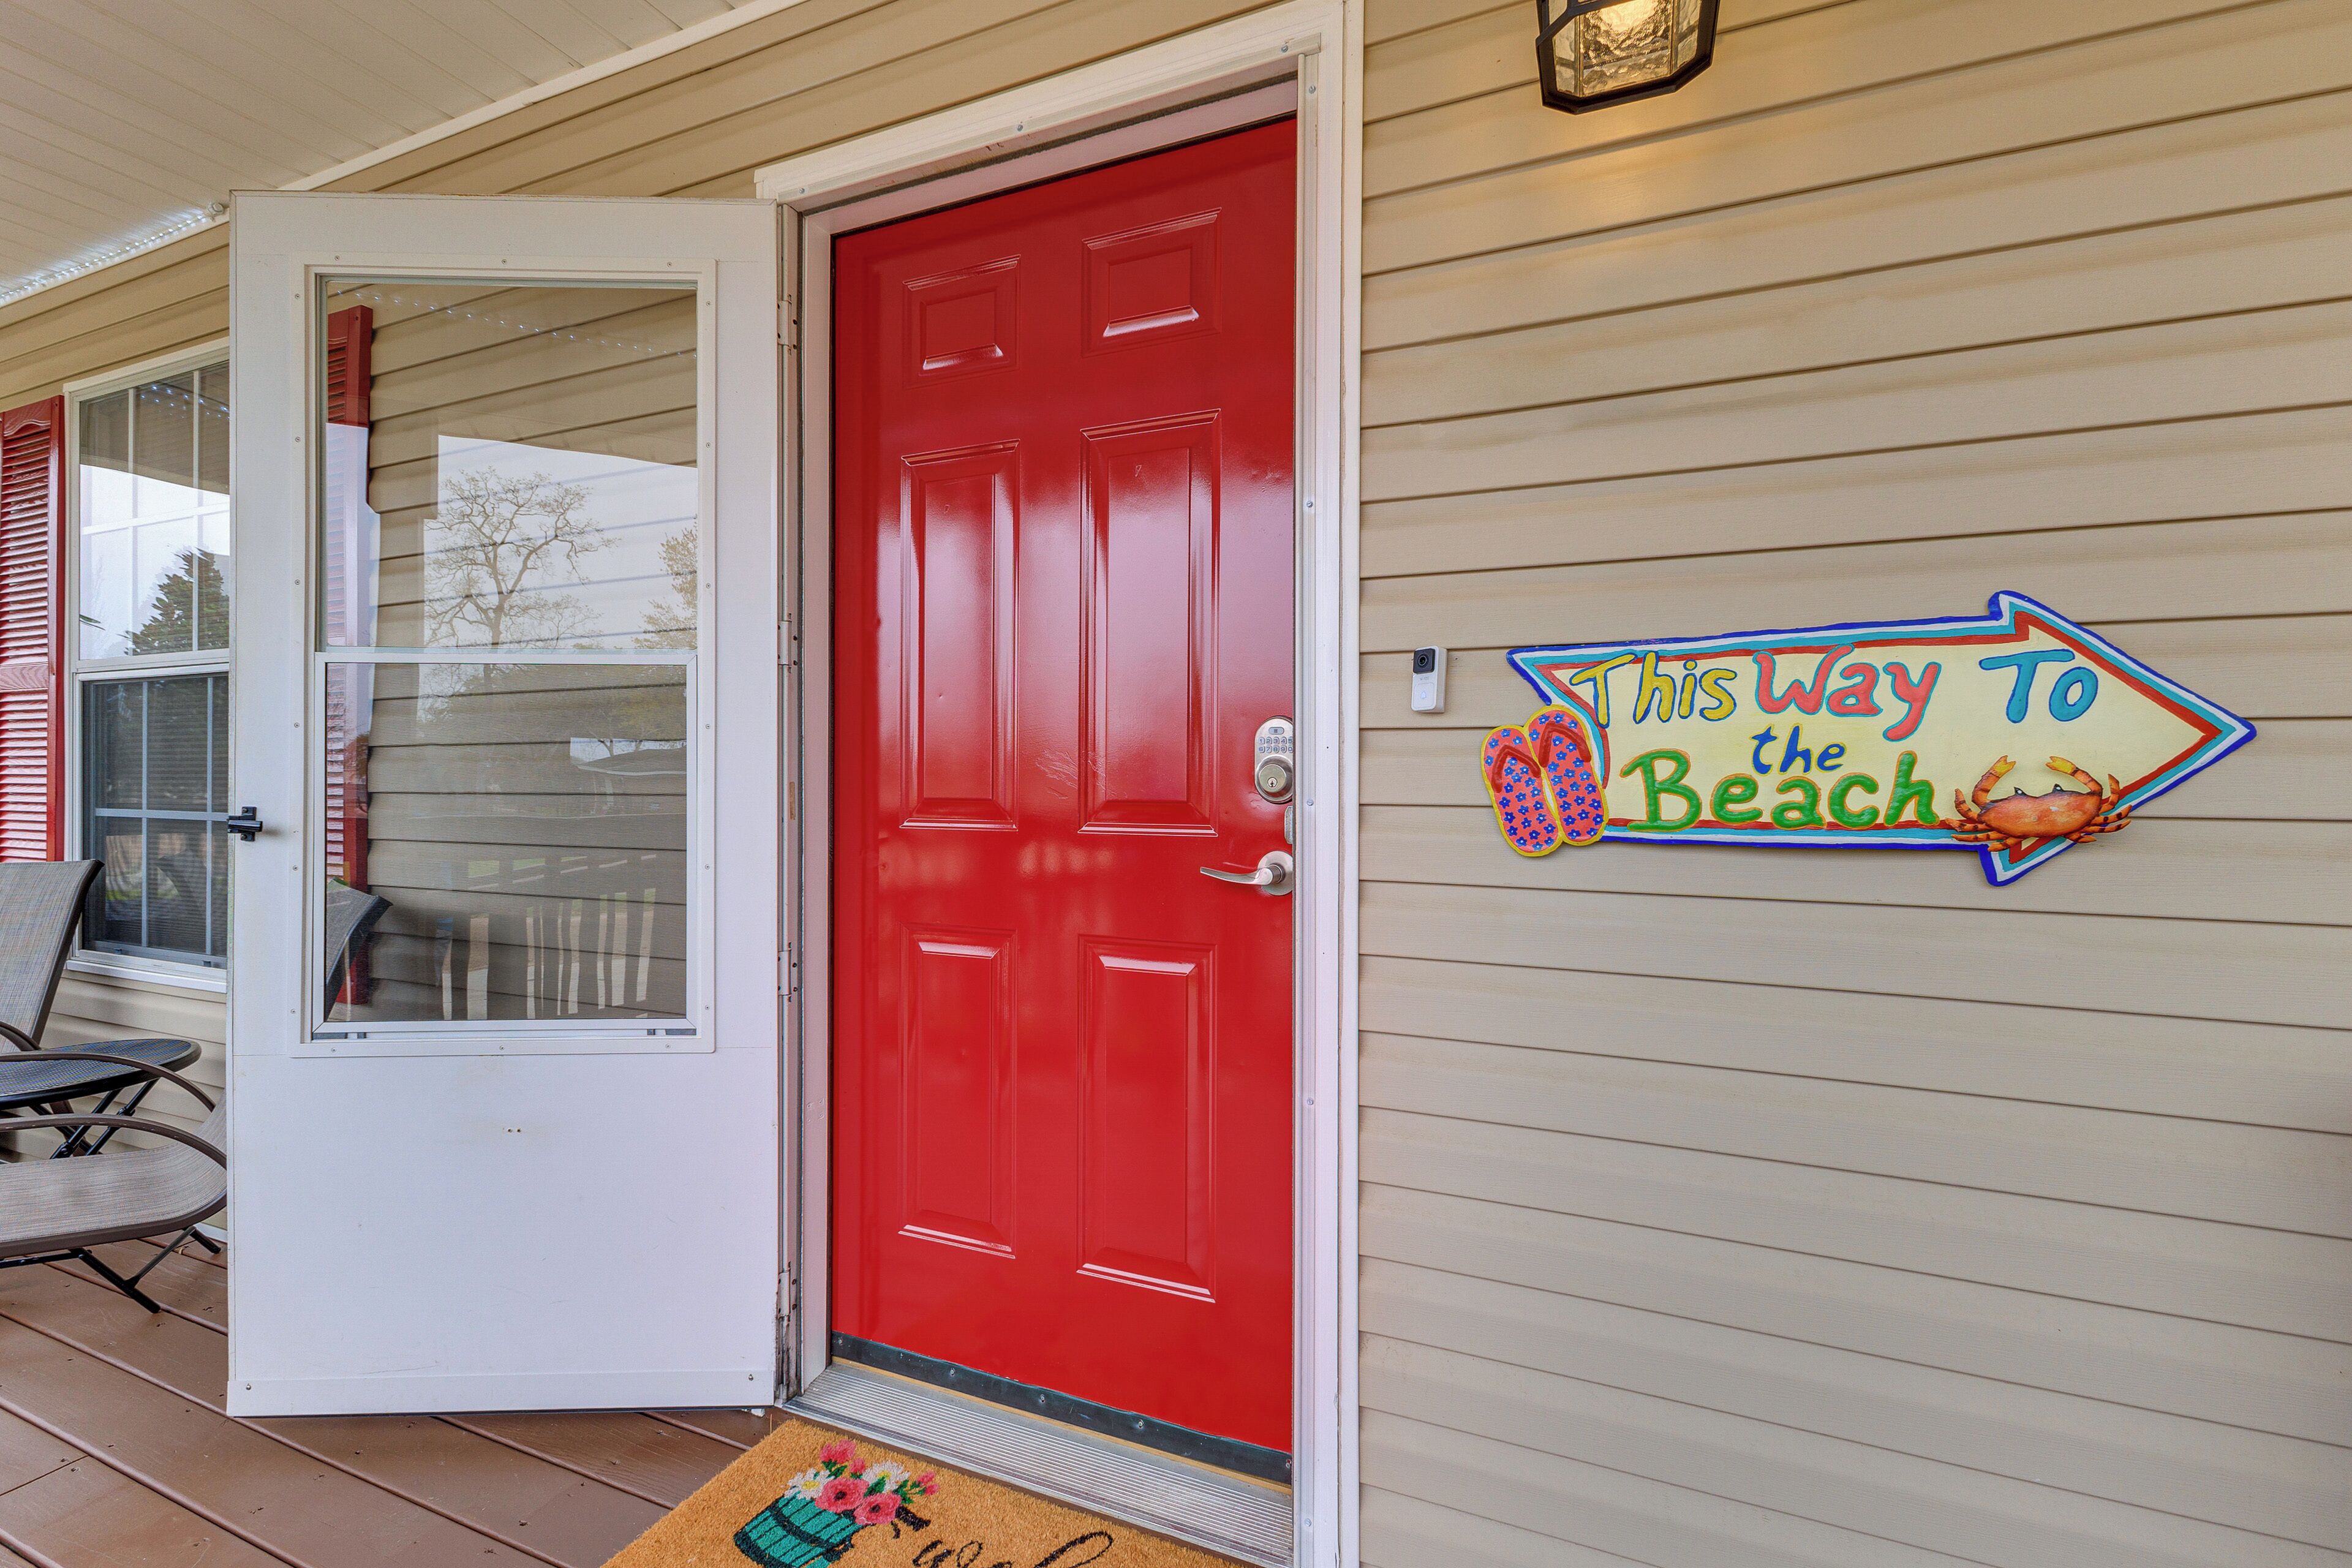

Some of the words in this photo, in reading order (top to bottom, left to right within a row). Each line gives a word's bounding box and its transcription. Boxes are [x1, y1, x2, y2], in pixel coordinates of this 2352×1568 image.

[1570, 651, 1737, 729] This
[1752, 644, 1942, 741] Way
[1978, 649, 2098, 723] To
[1620, 748, 1940, 831] Beach
[1750, 723, 1846, 774] the
